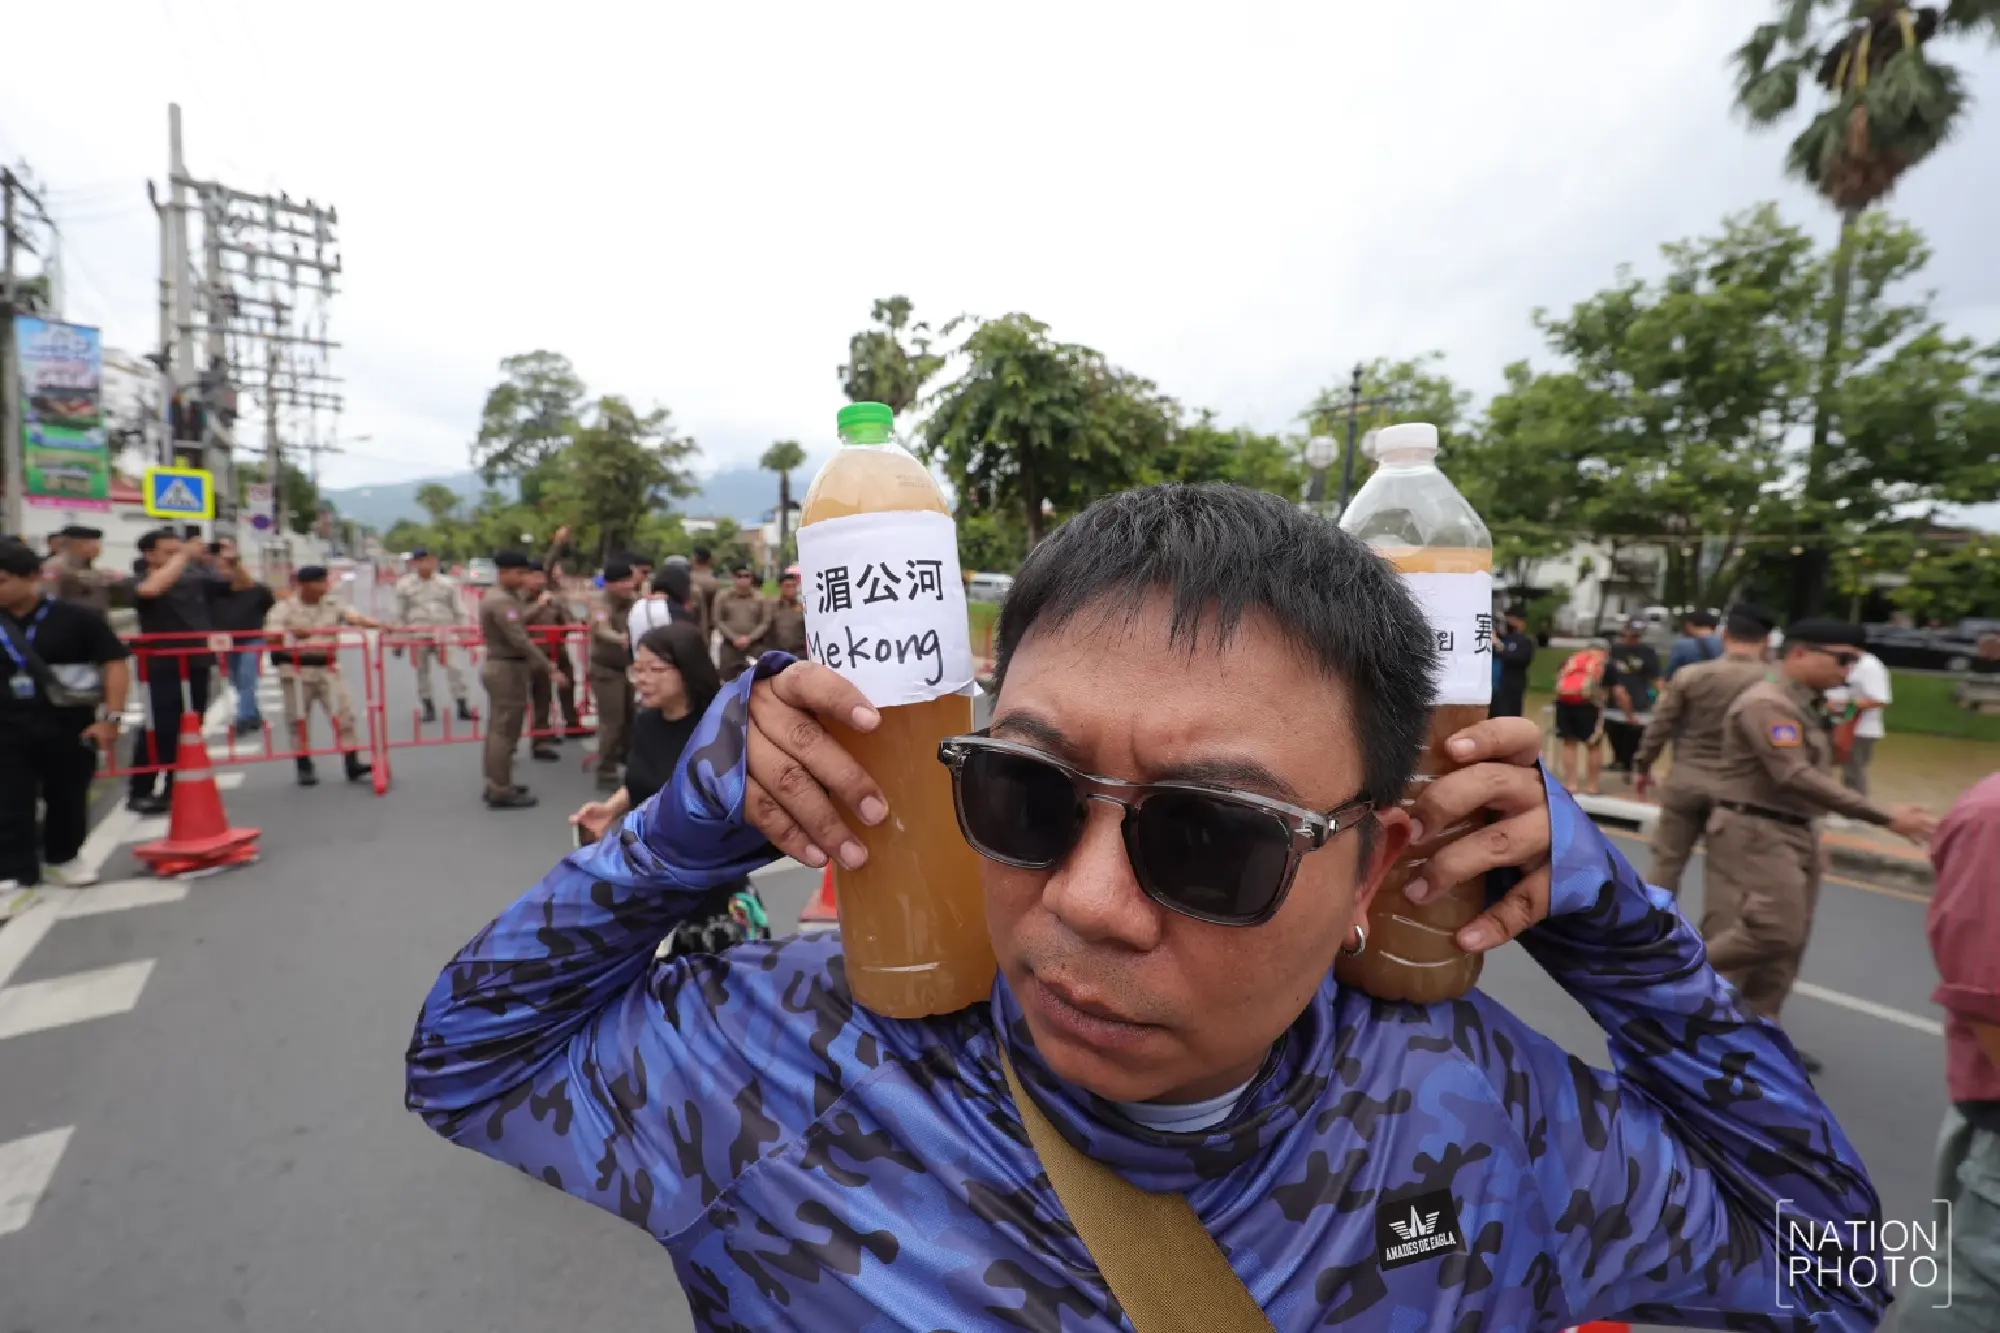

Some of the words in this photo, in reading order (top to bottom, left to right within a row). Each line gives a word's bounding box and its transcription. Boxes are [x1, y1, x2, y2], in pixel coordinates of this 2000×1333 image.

[816, 559, 943, 613] 湄公河
[807, 626, 943, 686] Mekong
[1419, 1238, 1431, 1253] DE
